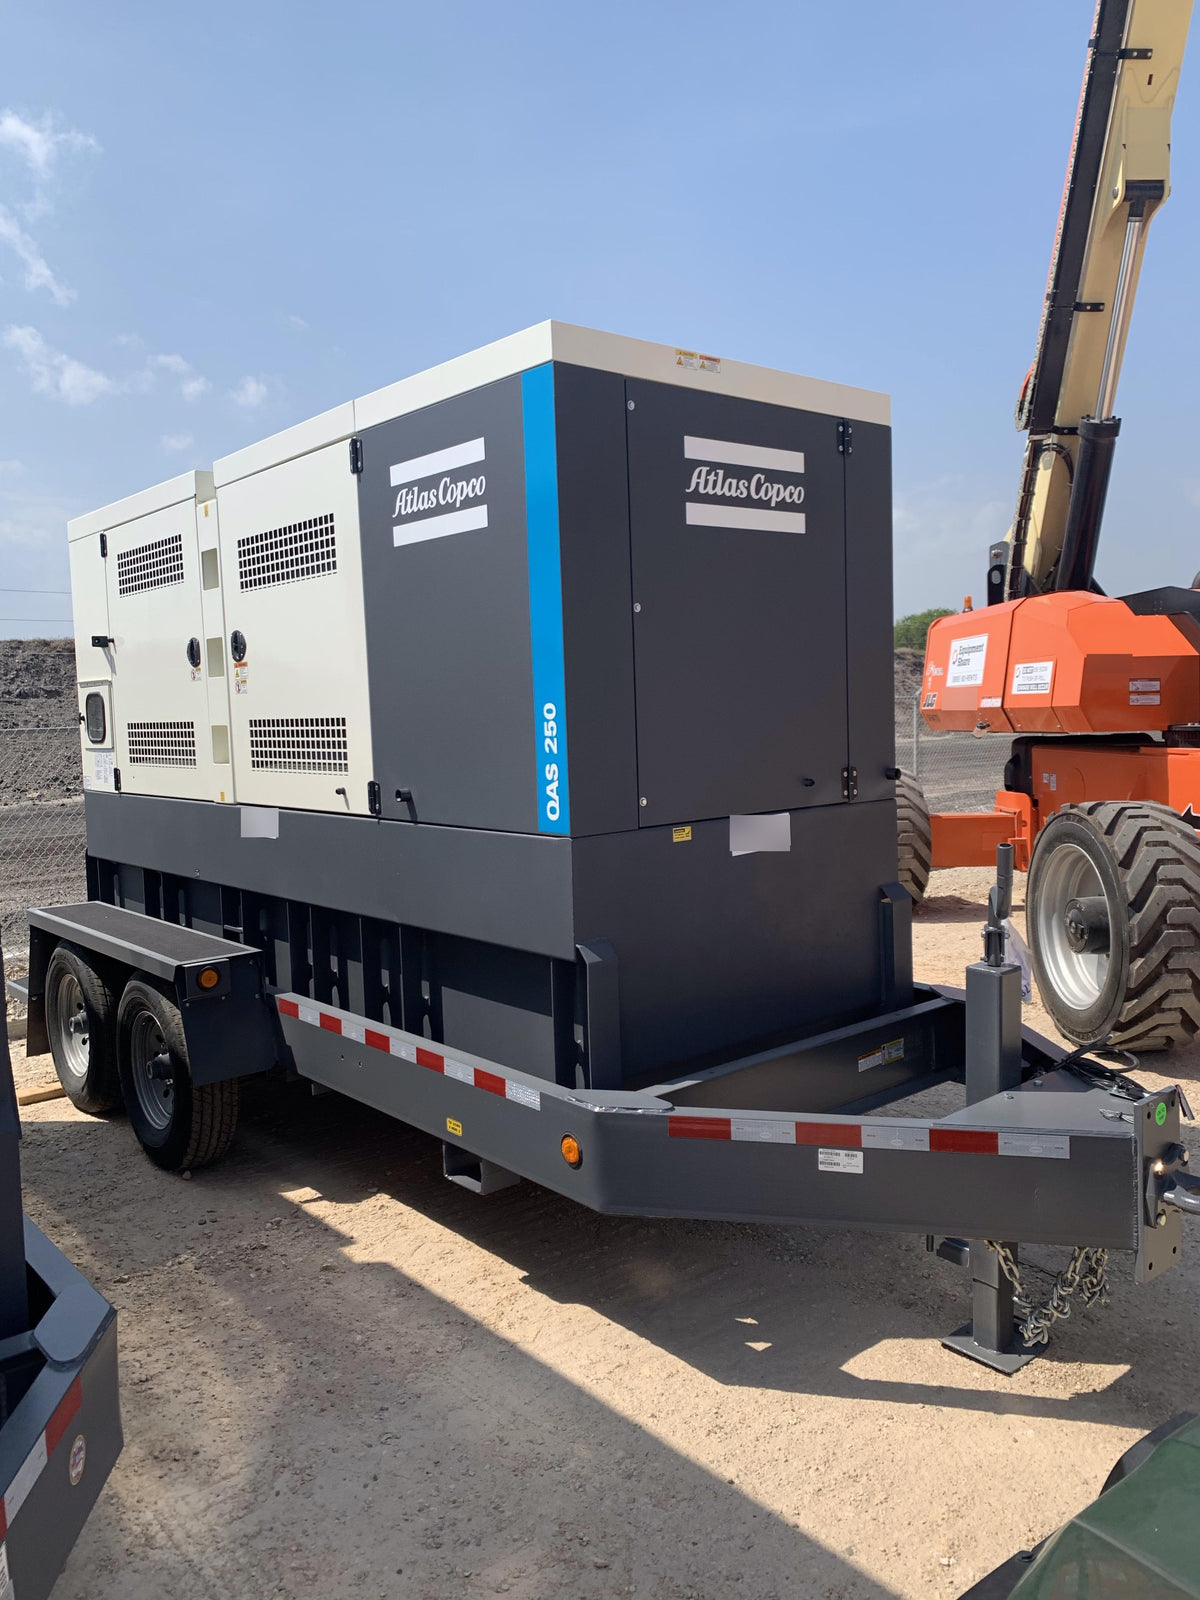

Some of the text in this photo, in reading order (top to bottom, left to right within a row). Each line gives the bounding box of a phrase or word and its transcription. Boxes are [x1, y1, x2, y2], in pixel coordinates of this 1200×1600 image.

[392, 475, 486, 518] Atlas Copco
[685, 466, 805, 507] Atlas Copco
[922, 692, 938, 708] JLG
[543, 702, 560, 821] QAS 250
